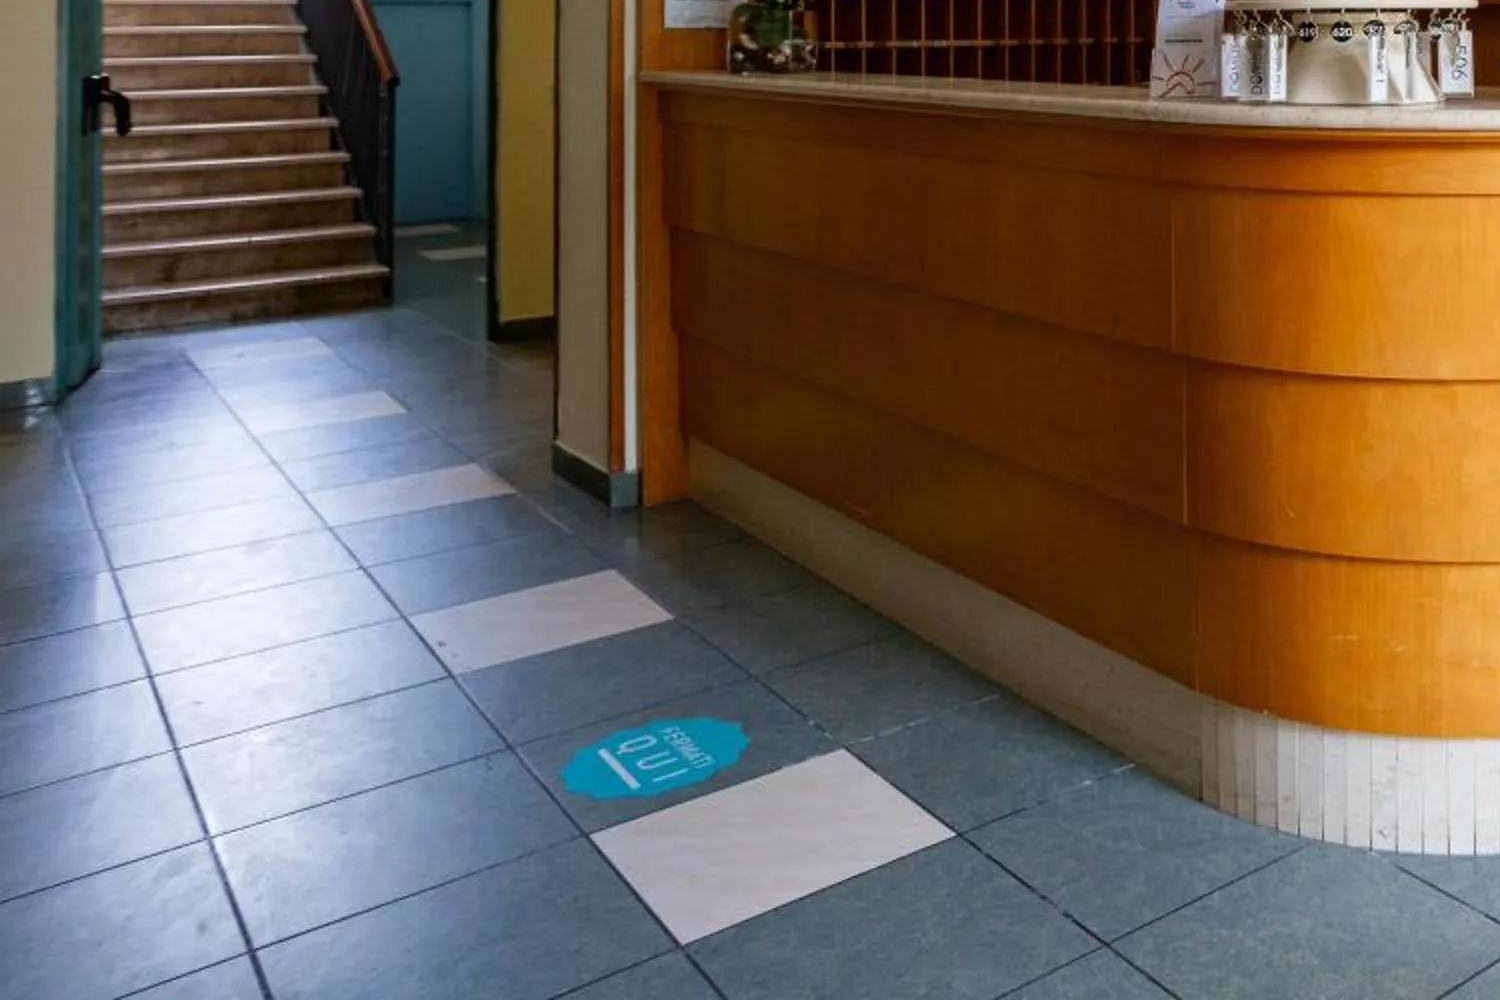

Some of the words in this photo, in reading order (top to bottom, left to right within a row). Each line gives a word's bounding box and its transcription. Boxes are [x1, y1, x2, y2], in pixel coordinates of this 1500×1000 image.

[1452, 44, 1469, 82] 506
[616, 734, 690, 783] QUI
[659, 725, 717, 769] FERMATI
